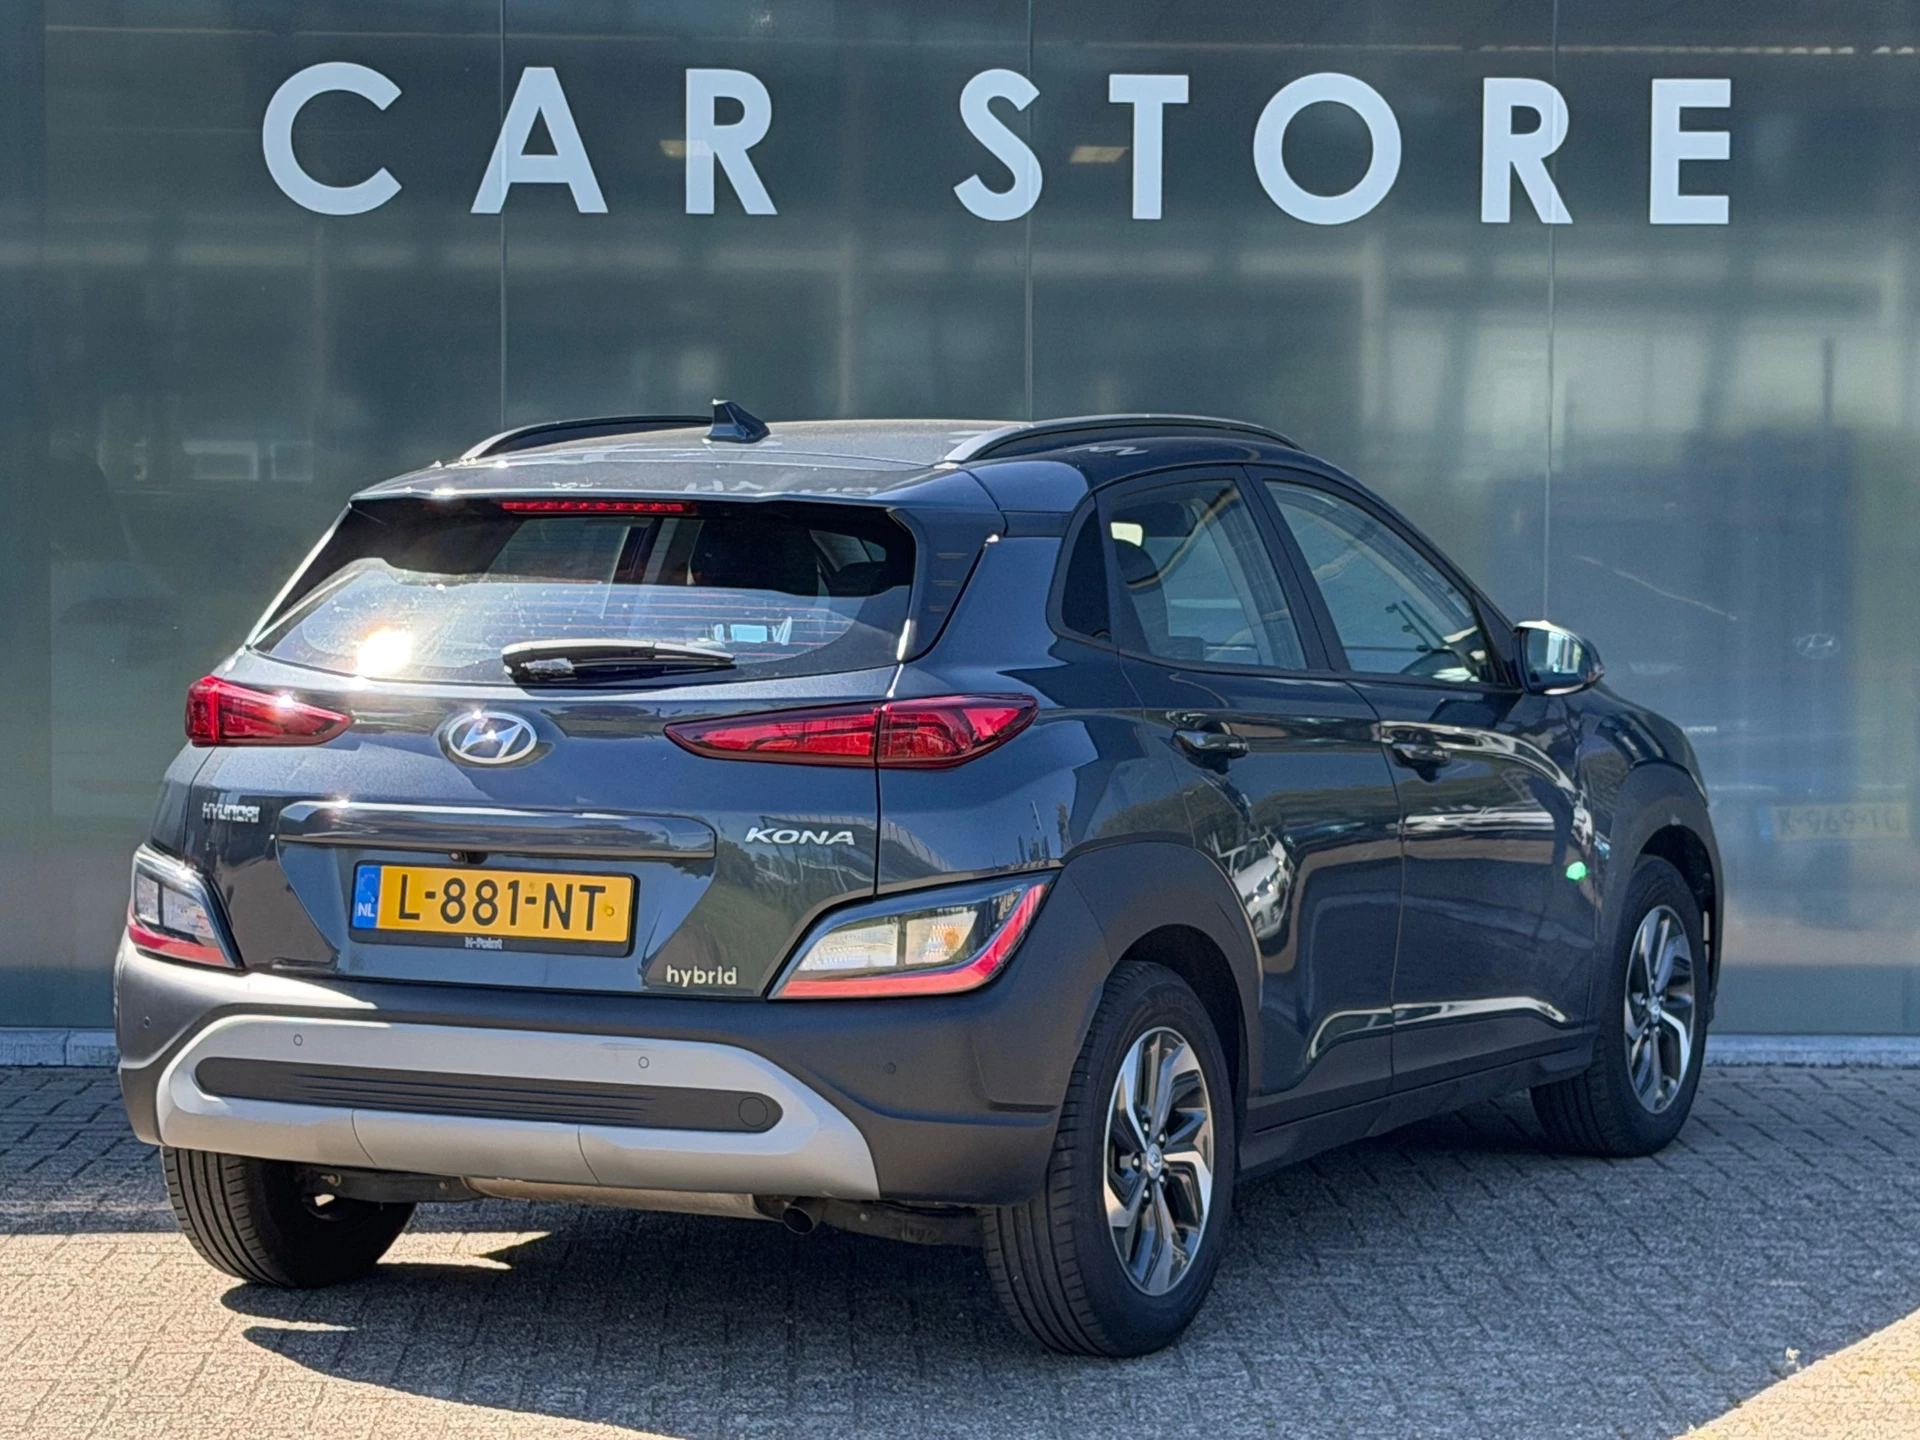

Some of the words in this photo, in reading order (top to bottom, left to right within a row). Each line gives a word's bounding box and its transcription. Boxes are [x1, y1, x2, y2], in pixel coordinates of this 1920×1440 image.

[263, 63, 777, 215] CAR
[954, 69, 1732, 225] STORE
[202, 801, 260, 824] HYUNDAI
[745, 827, 855, 845] KONA
[357, 902, 375, 918] NL
[398, 874, 606, 932] L-881-NT
[666, 965, 737, 988] hybrid
